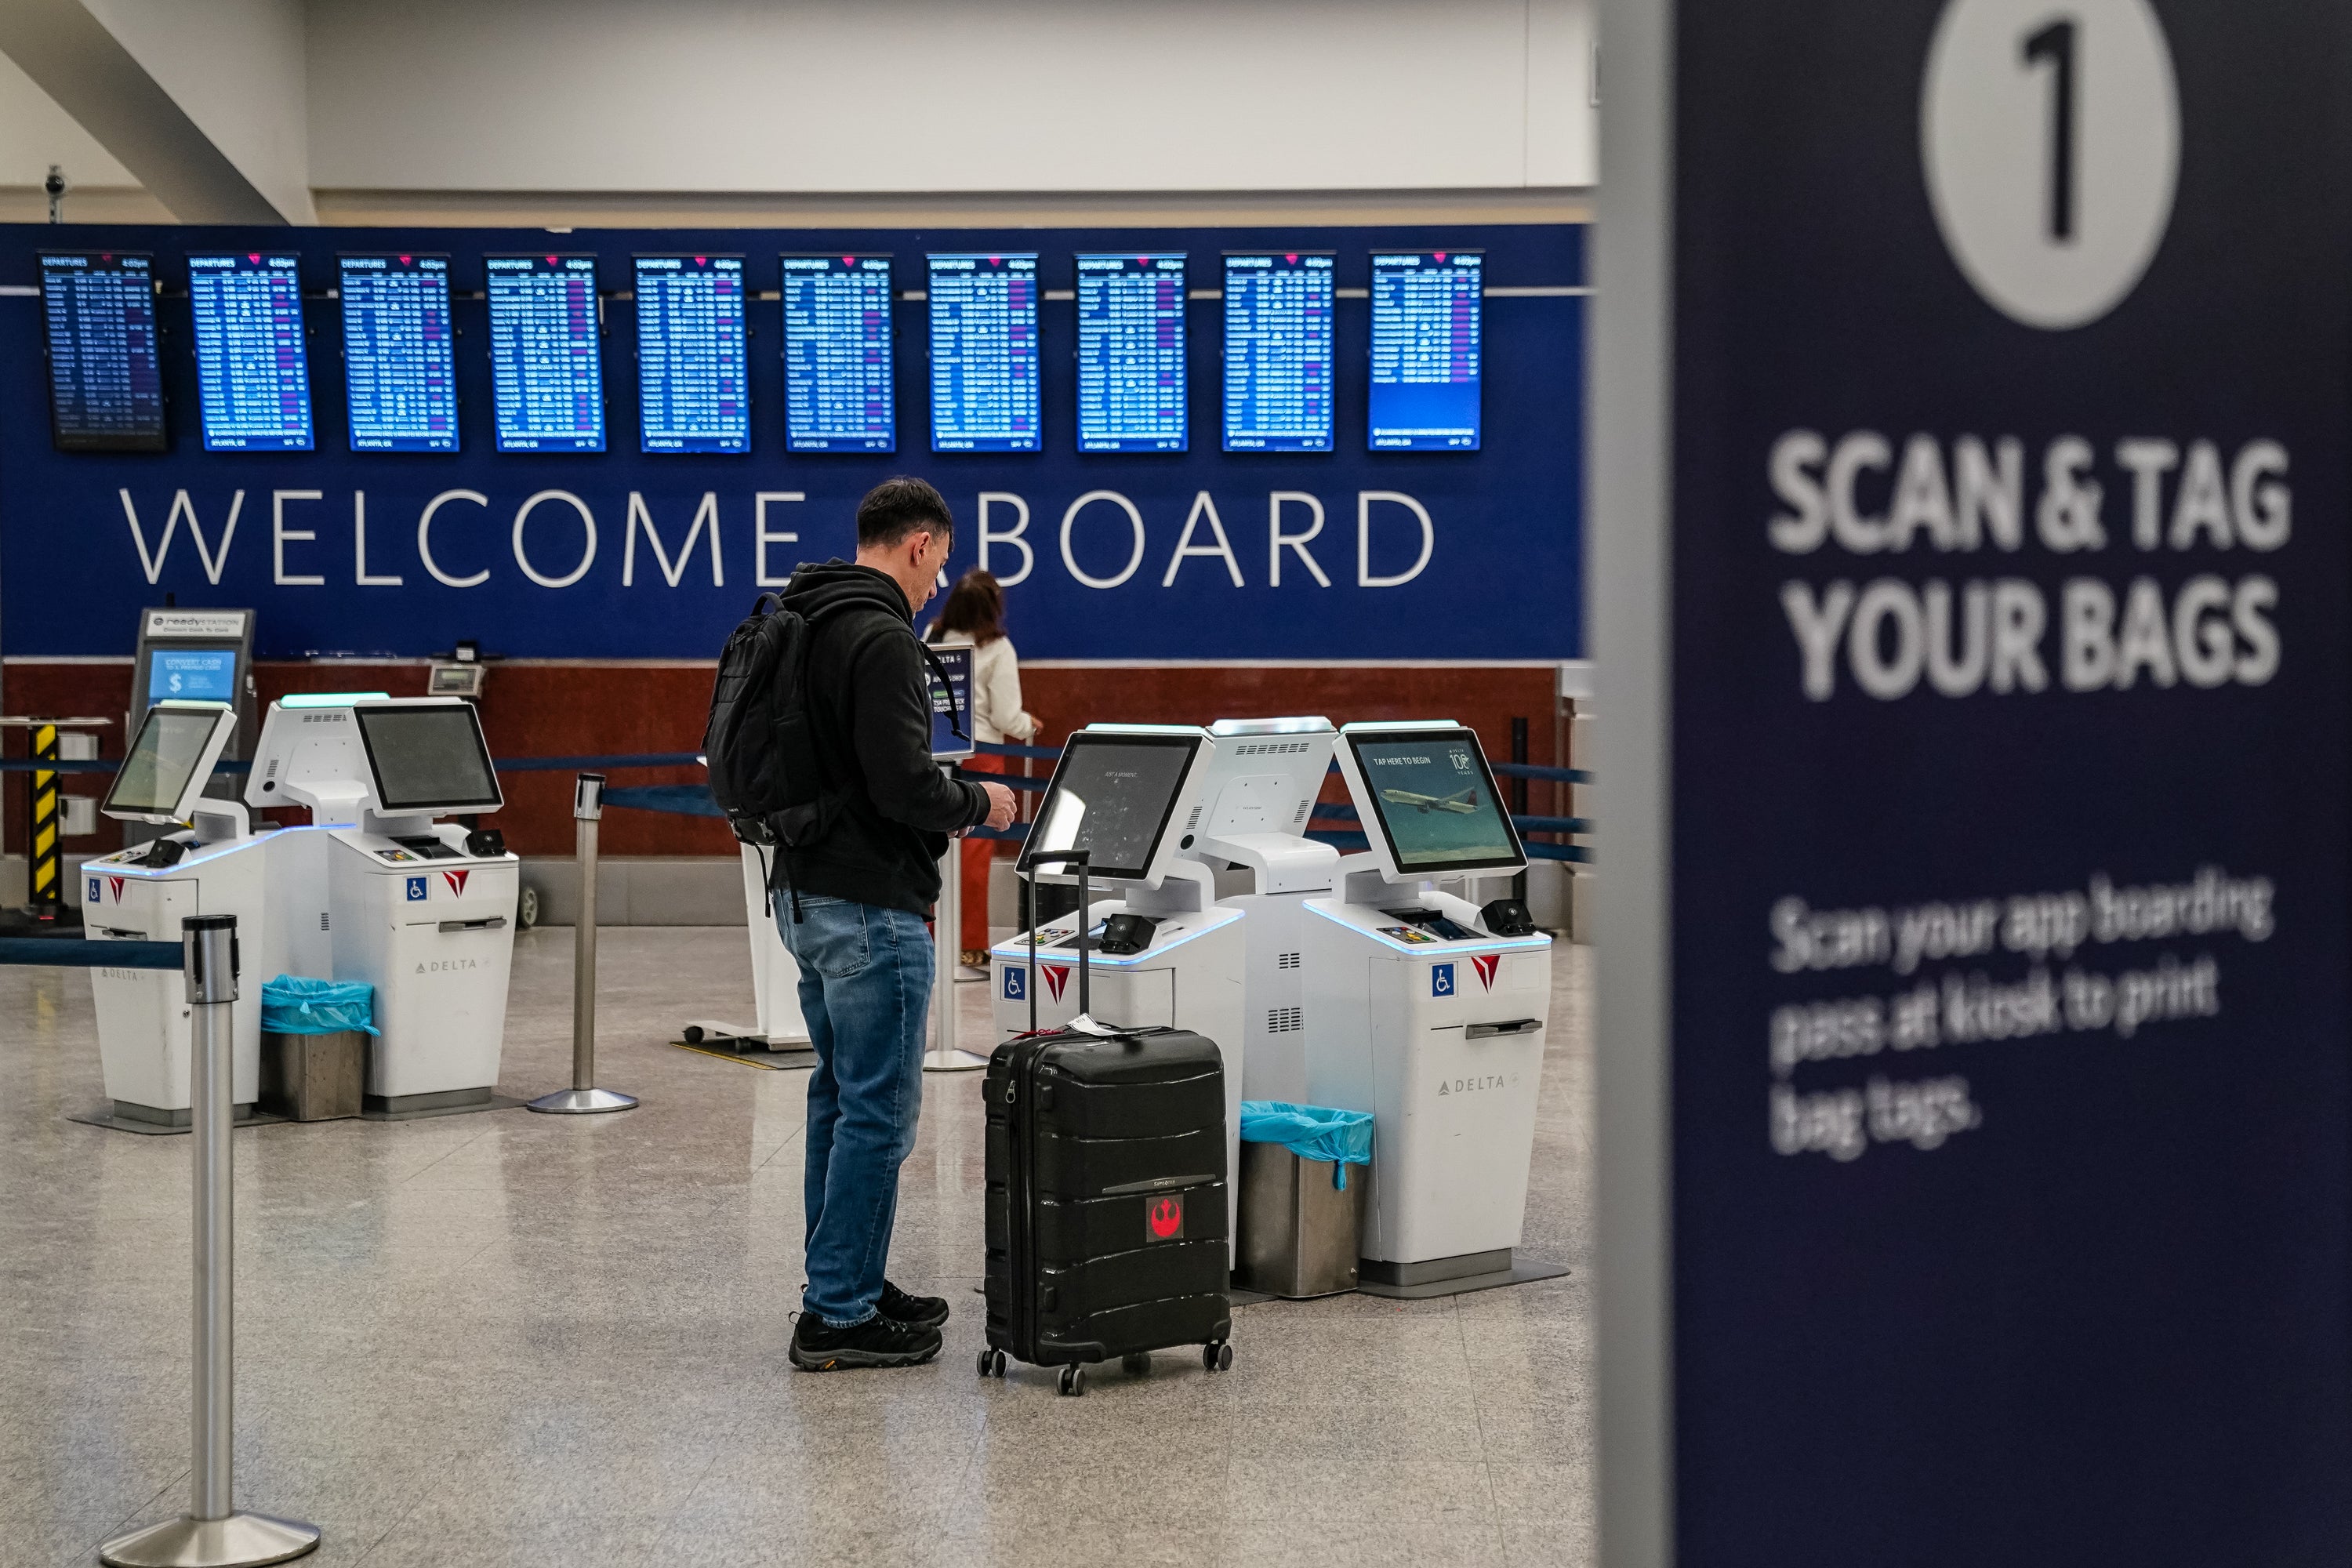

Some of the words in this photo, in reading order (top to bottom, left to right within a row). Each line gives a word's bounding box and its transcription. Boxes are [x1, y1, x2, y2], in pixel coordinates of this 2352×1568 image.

[2020, 16, 2079, 243] 1
[189, 257, 236, 268] DEPARTURES
[118, 488, 806, 587] WELCOME
[937, 489, 1435, 589] BOARD
[1769, 431, 2023, 551] SCAN
[2038, 434, 2106, 551] &
[2115, 436, 2291, 550] TAG
[1780, 579, 2048, 700] YOUR
[2062, 575, 2280, 691] BAGS
[430, 959, 477, 971] DELTA
[1770, 897, 1889, 972] Scan
[1893, 901, 1997, 975] your
[2002, 893, 2087, 959] app
[2088, 866, 2273, 942] boarding
[110, 968, 138, 982] DELTA
[1770, 1004, 1882, 1077] pass
[1889, 983, 1940, 1051] at
[1941, 964, 2060, 1044] kiosk
[2063, 966, 2114, 1030] to
[2116, 951, 2219, 1038] print
[1454, 1075, 1504, 1093] DELTA
[1770, 1082, 1866, 1160] bag
[1867, 1076, 1980, 1150] tags.
